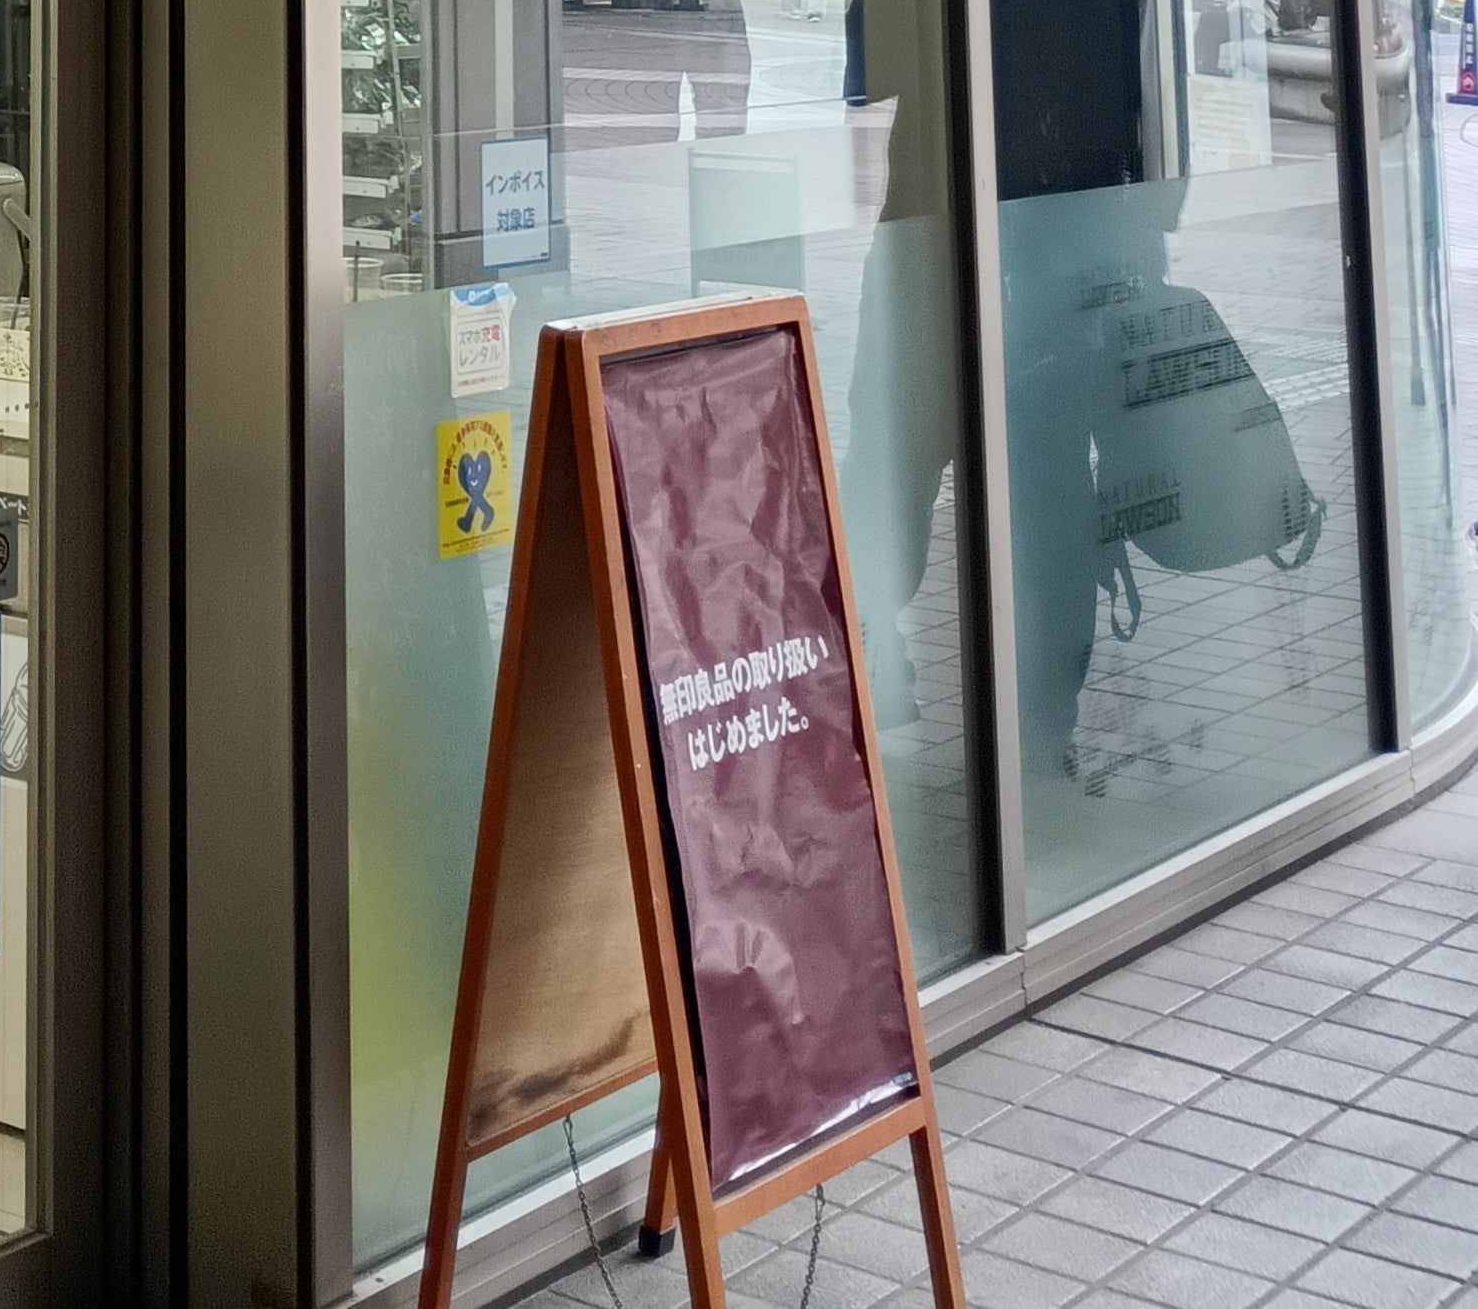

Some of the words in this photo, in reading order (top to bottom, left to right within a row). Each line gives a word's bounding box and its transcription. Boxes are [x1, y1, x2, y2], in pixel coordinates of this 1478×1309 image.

[485, 169, 545, 195] インボイス
[496, 206, 536, 232] 対象店
[458, 323, 501, 345] スマホ充電
[458, 344, 500, 367] レンタル
[659, 634, 829, 726] 無印良品の取り扱い
[687, 696, 810, 772] はじめました。
